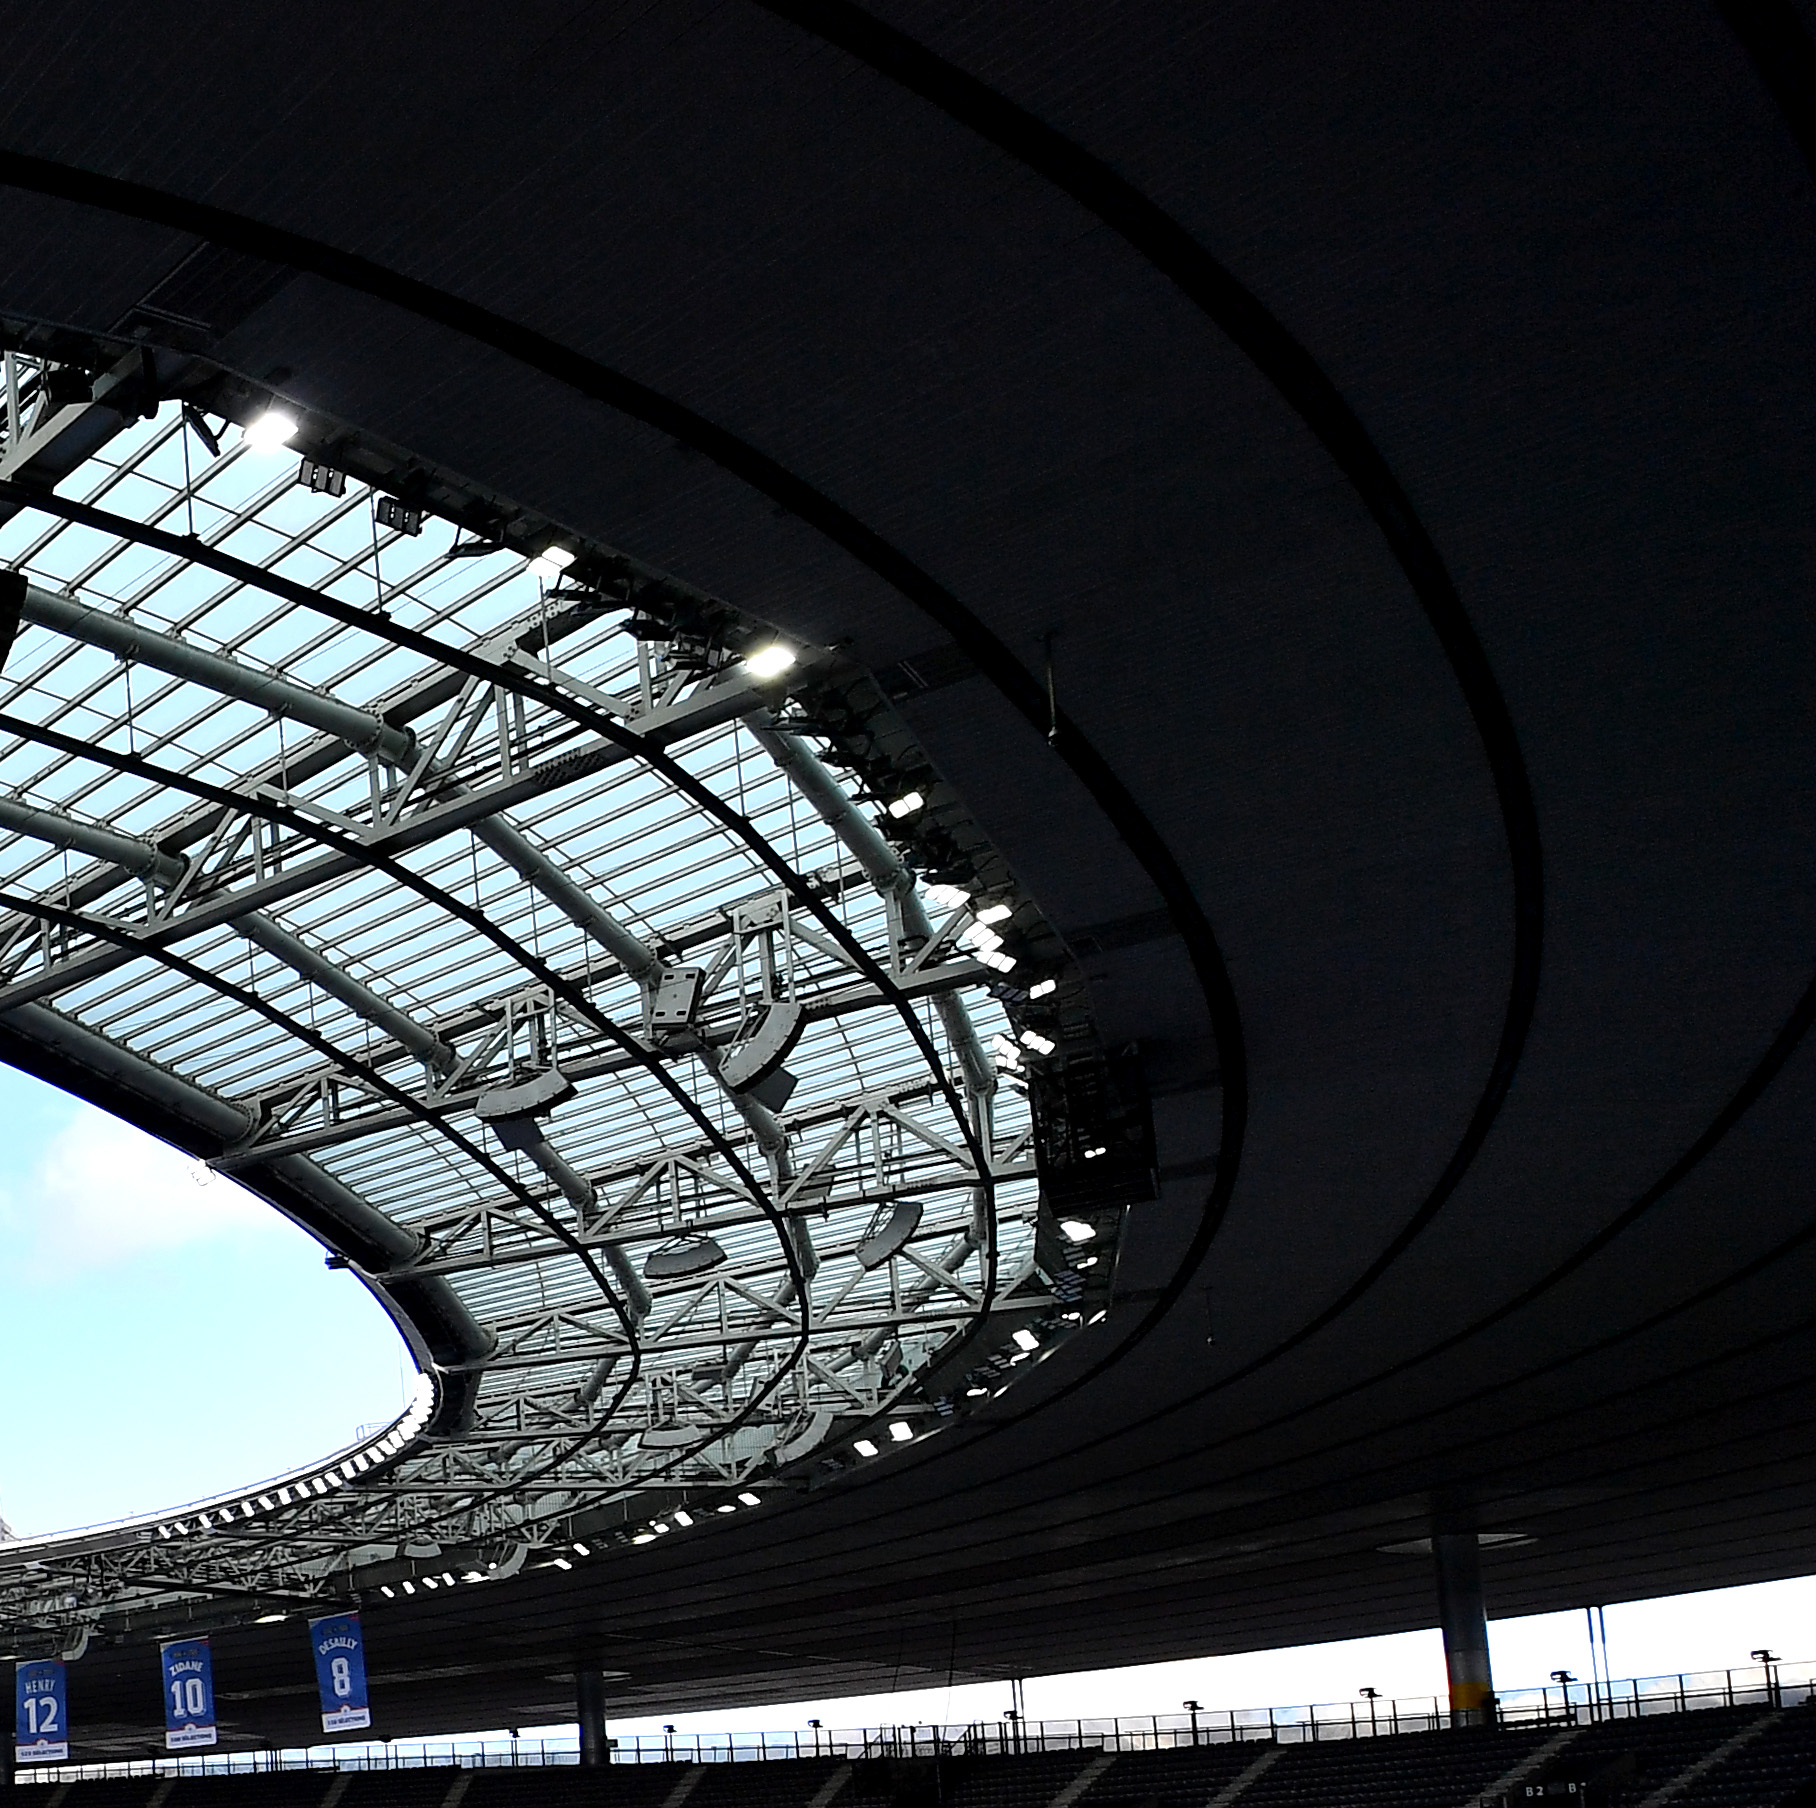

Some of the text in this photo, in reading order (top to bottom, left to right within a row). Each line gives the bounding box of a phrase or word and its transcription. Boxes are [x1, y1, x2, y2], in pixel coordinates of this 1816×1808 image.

[319, 1638, 357, 1655] DESAILLY
[169, 1662, 203, 1677] ZIDANE
[331, 1657, 351, 1698] 8
[25, 1680, 55, 1694] HENRY
[171, 1678, 205, 1718] 10
[24, 1697, 58, 1734] 12
[1526, 1786, 1544, 1797] B2
